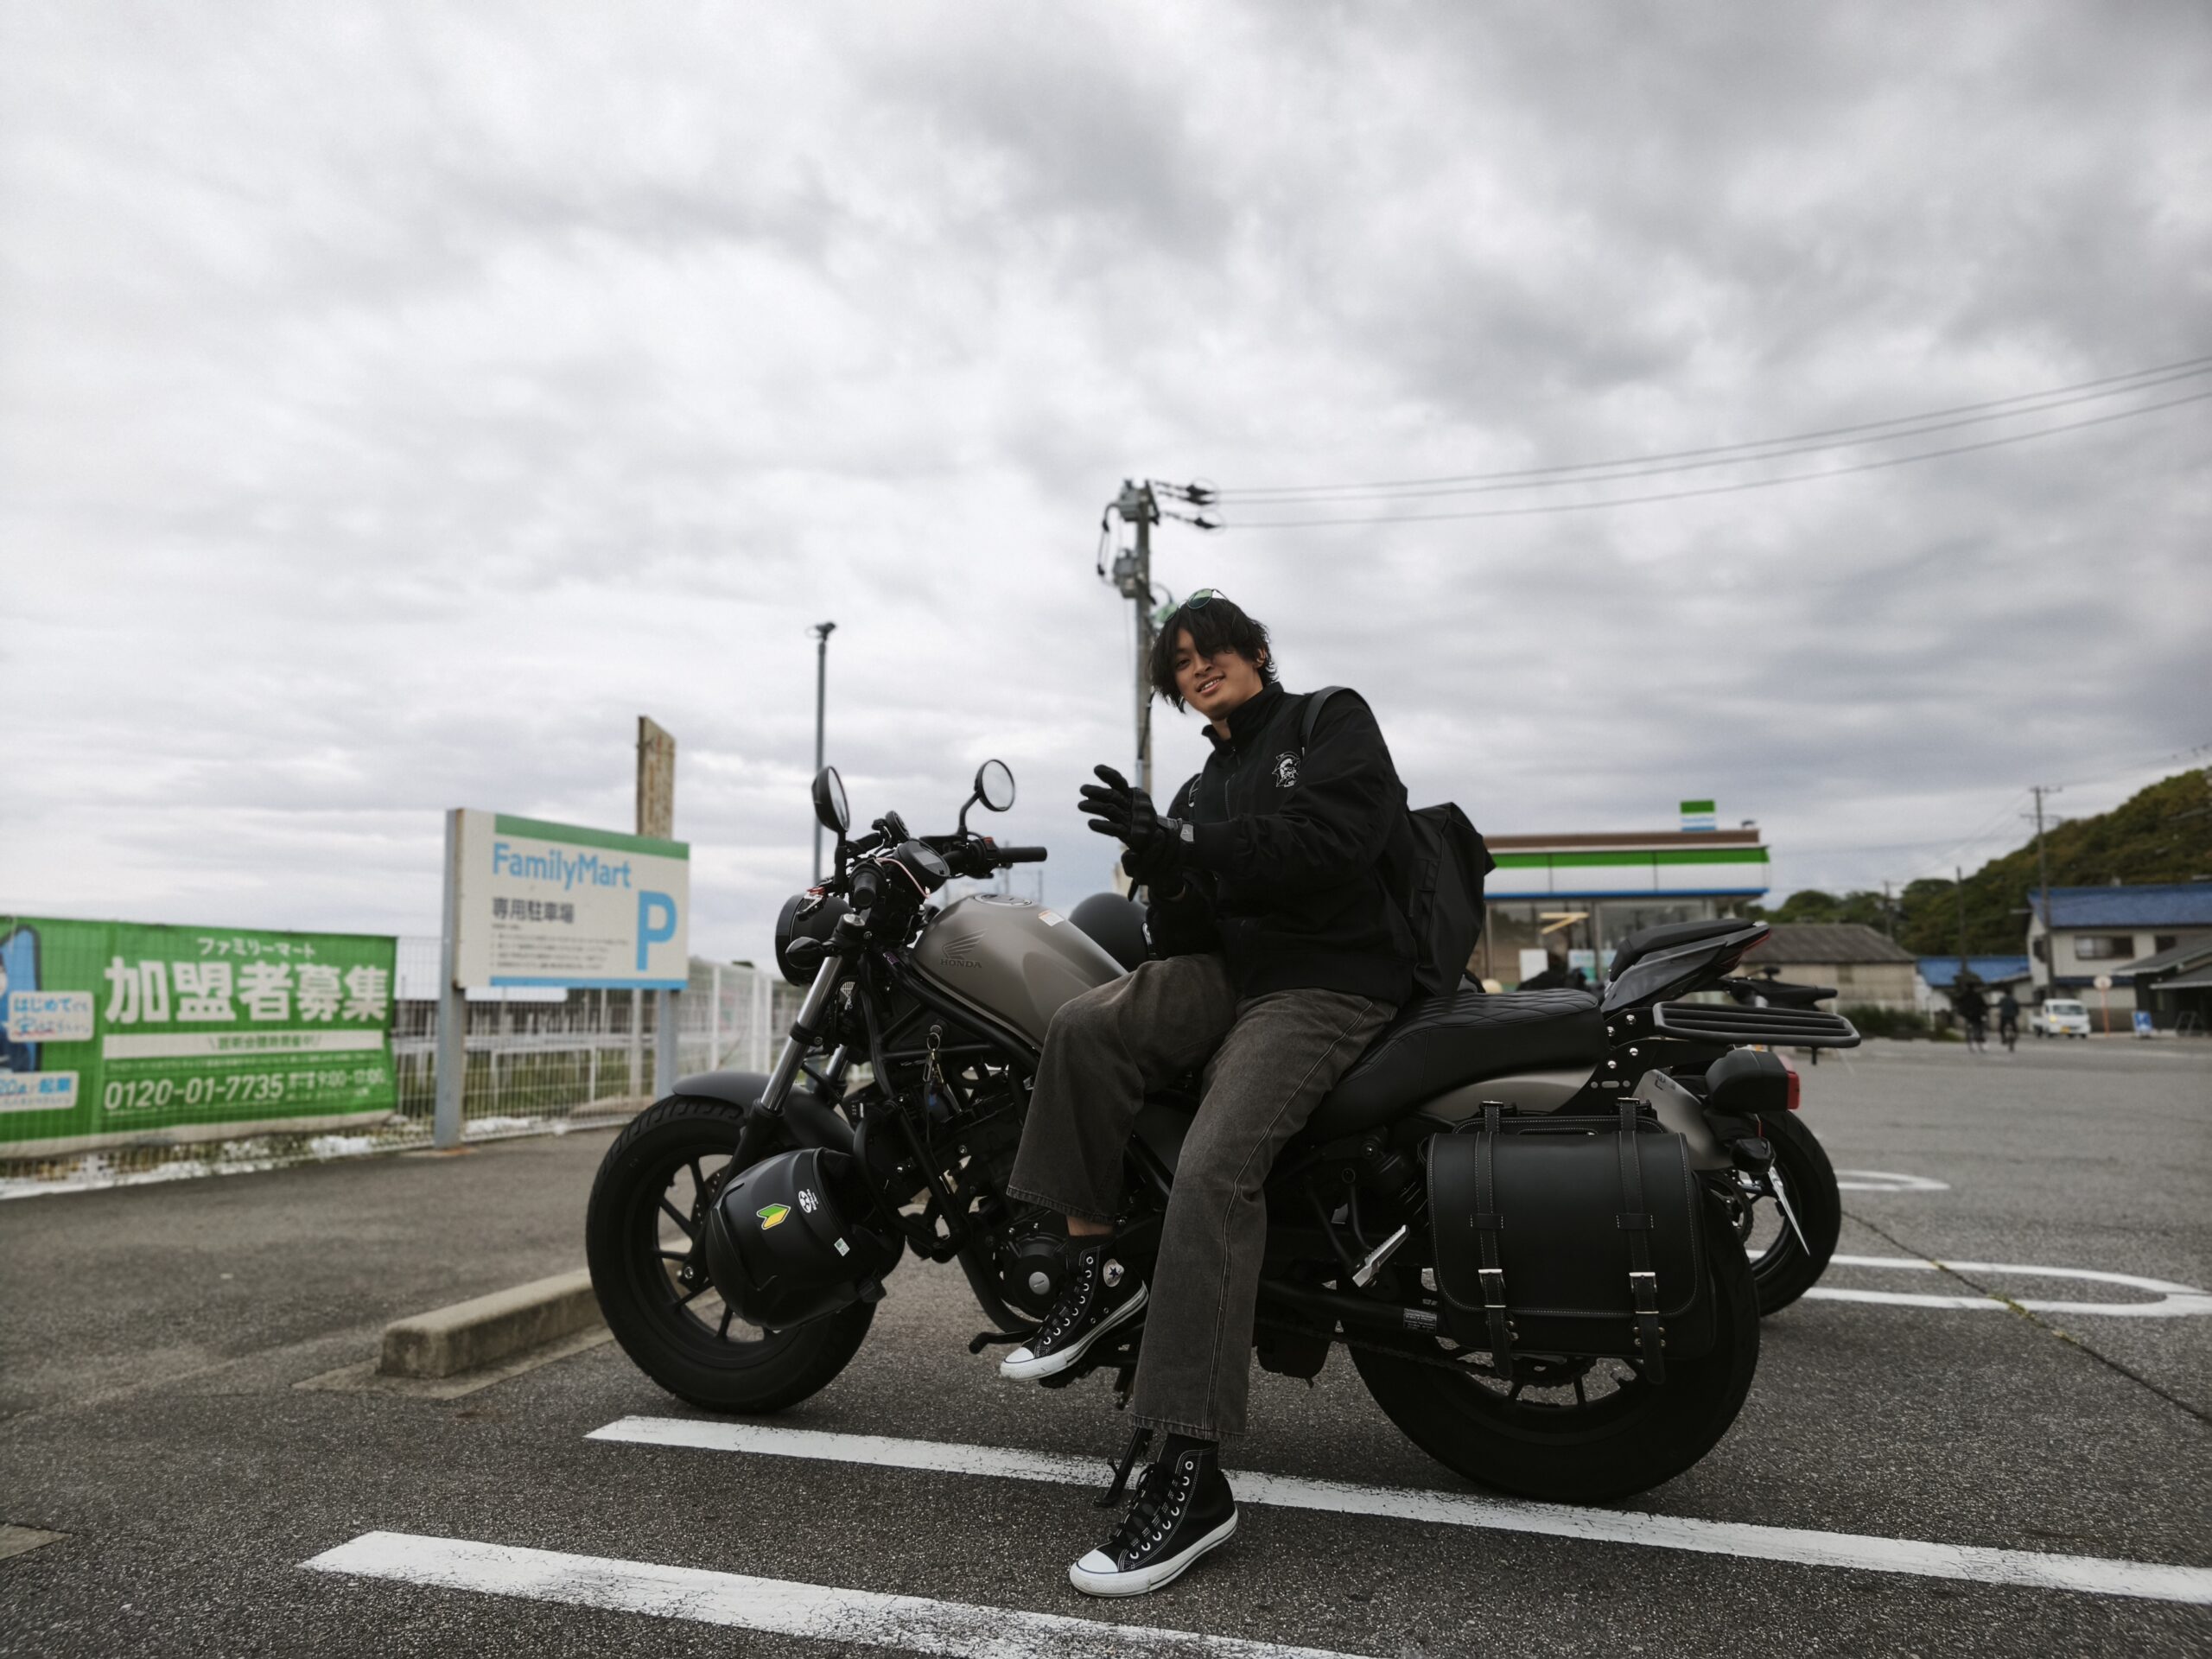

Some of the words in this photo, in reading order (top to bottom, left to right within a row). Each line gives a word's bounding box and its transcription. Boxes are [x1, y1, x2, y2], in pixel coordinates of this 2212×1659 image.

[493, 842, 632, 891] FamilyMart
[492, 897, 575, 924] 専用駐車場
[197, 938, 316, 958] ファミリーマート
[636, 889, 678, 972] P
[940, 959, 982, 969] HONDA
[104, 956, 389, 1024] 加盟者募集
[104, 1073, 284, 1109] 0120-01-7735
